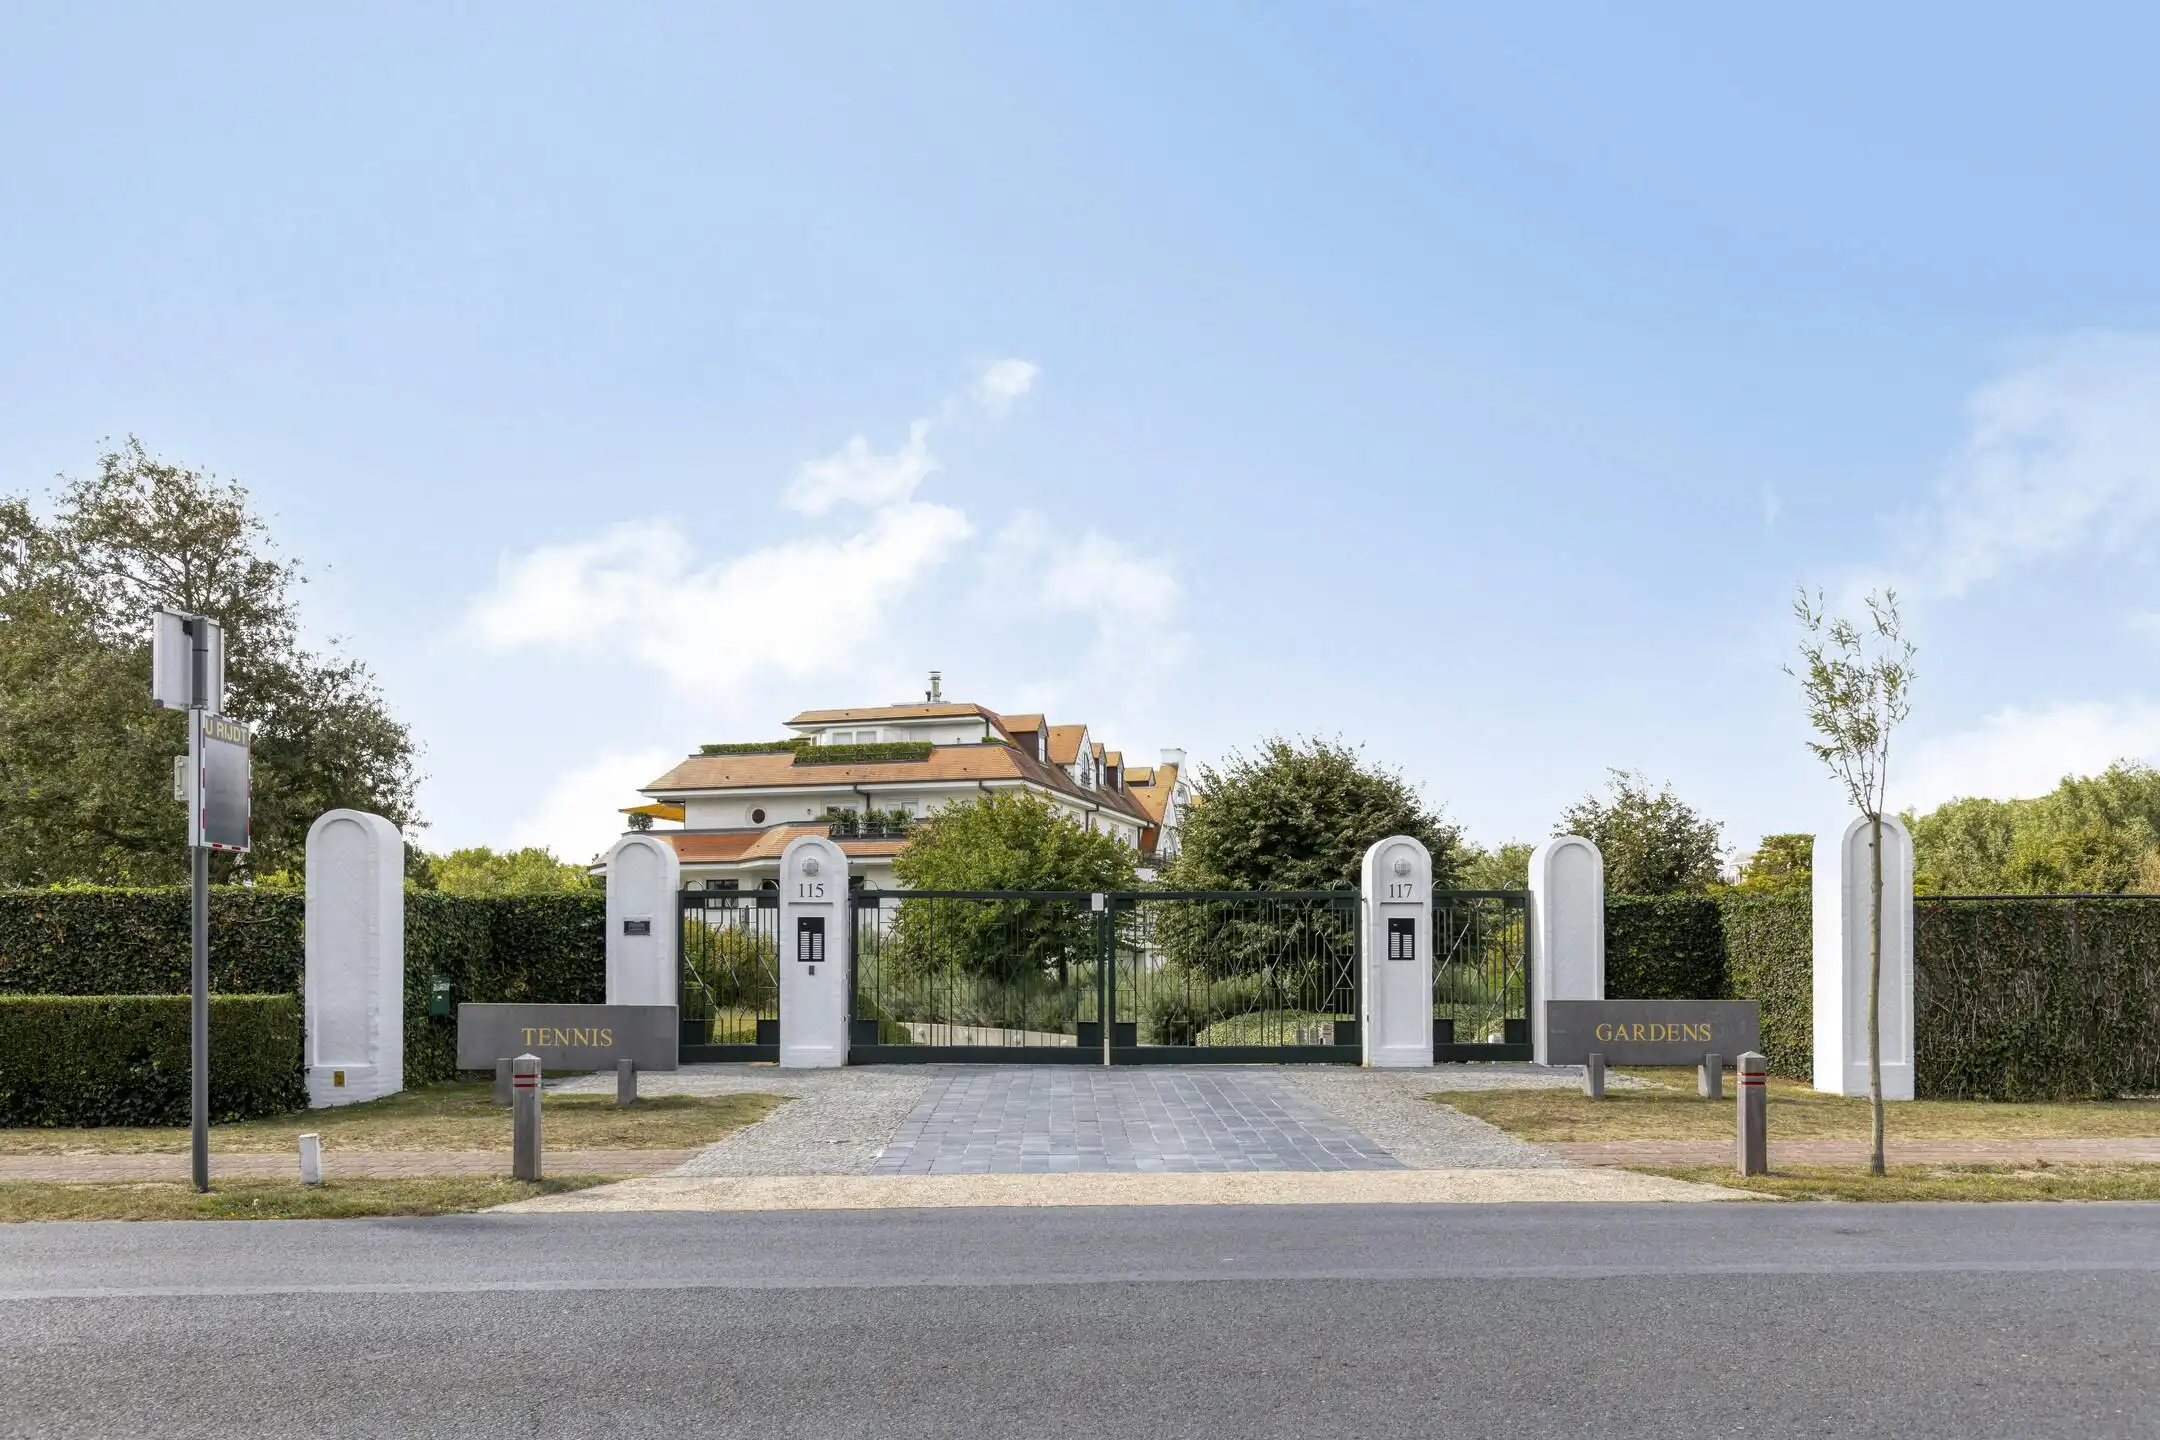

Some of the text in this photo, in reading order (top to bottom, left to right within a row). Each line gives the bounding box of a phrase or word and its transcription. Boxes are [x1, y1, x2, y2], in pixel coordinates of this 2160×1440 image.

[205, 718, 248, 745] U RIJDT
[799, 883, 824, 898] 115
[1388, 883, 1413, 898] 117
[520, 1027, 613, 1047] TENNIS
[1595, 1023, 1712, 1042] GARDENS
